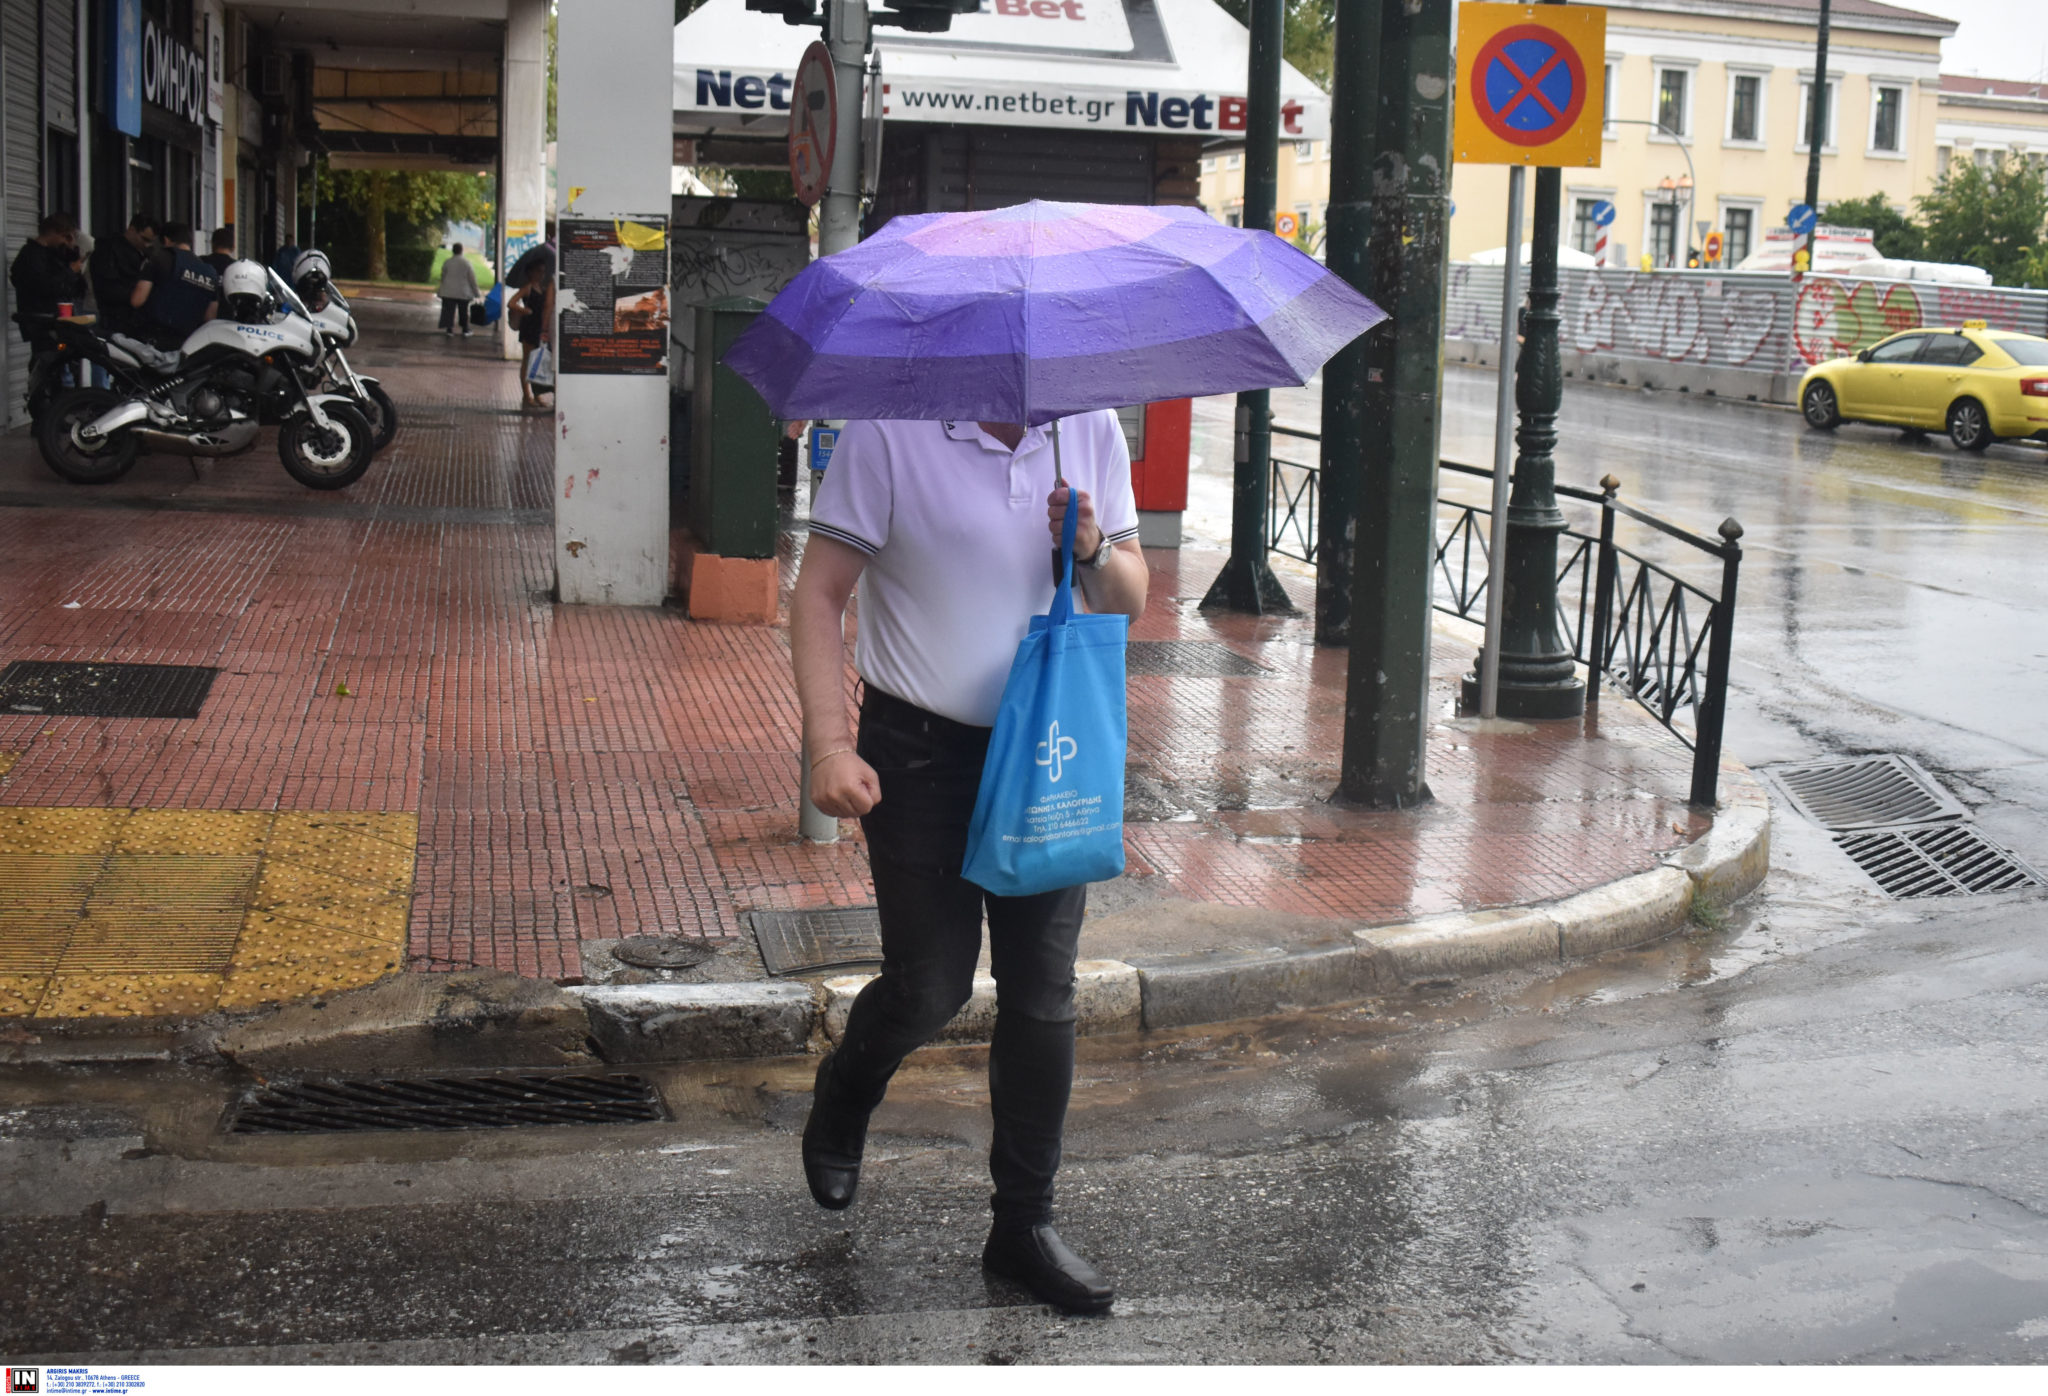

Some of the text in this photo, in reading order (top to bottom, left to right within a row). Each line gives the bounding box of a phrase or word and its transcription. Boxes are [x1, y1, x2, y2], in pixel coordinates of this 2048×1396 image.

[144, 20, 204, 126] ΟΜΗΡΟΣ
[902, 90, 1114, 122] www.netbet.gr
[1125, 91, 1304, 134] NetBt
[237, 325, 285, 342] POLICE
